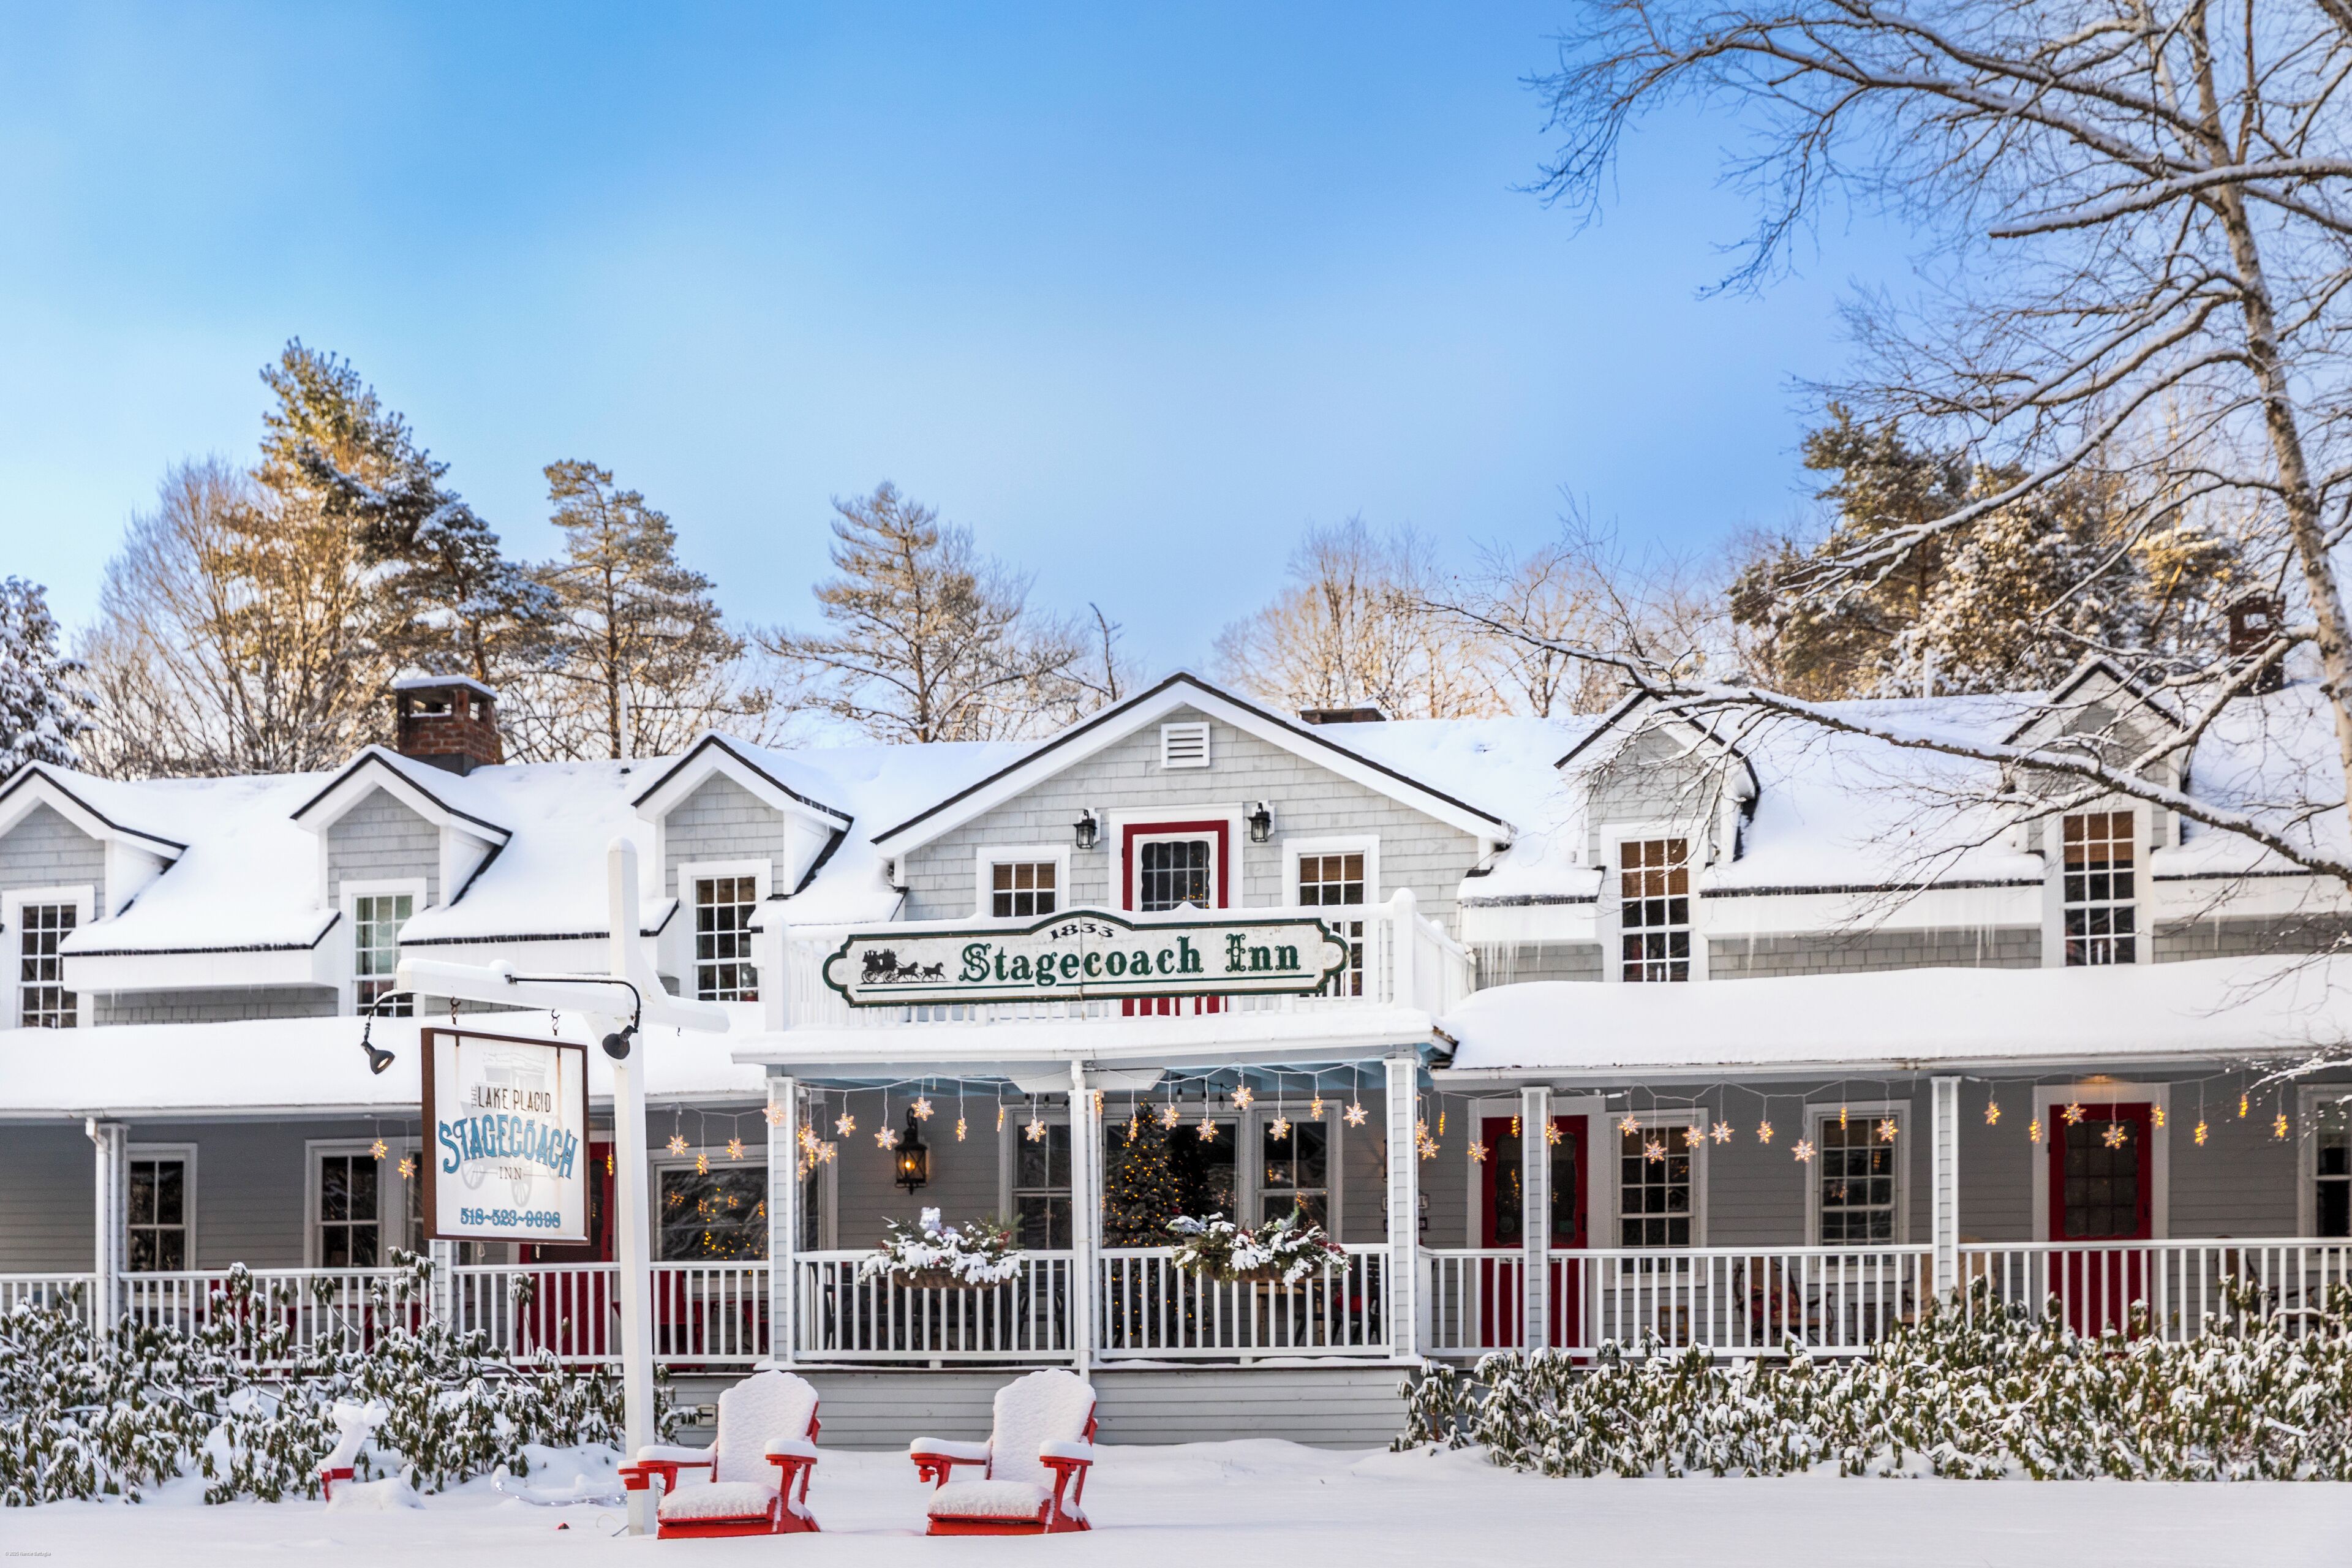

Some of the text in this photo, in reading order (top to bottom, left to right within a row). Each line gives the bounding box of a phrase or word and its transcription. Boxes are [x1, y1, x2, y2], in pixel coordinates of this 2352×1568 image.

[1050, 923, 1114, 941] 1833
[959, 933, 1301, 986] Stagecoach Inn
[478, 1086, 551, 1112] LAKE PLACID
[439, 1114, 578, 1180] STAGECOACH
[499, 1166, 522, 1180] INN
